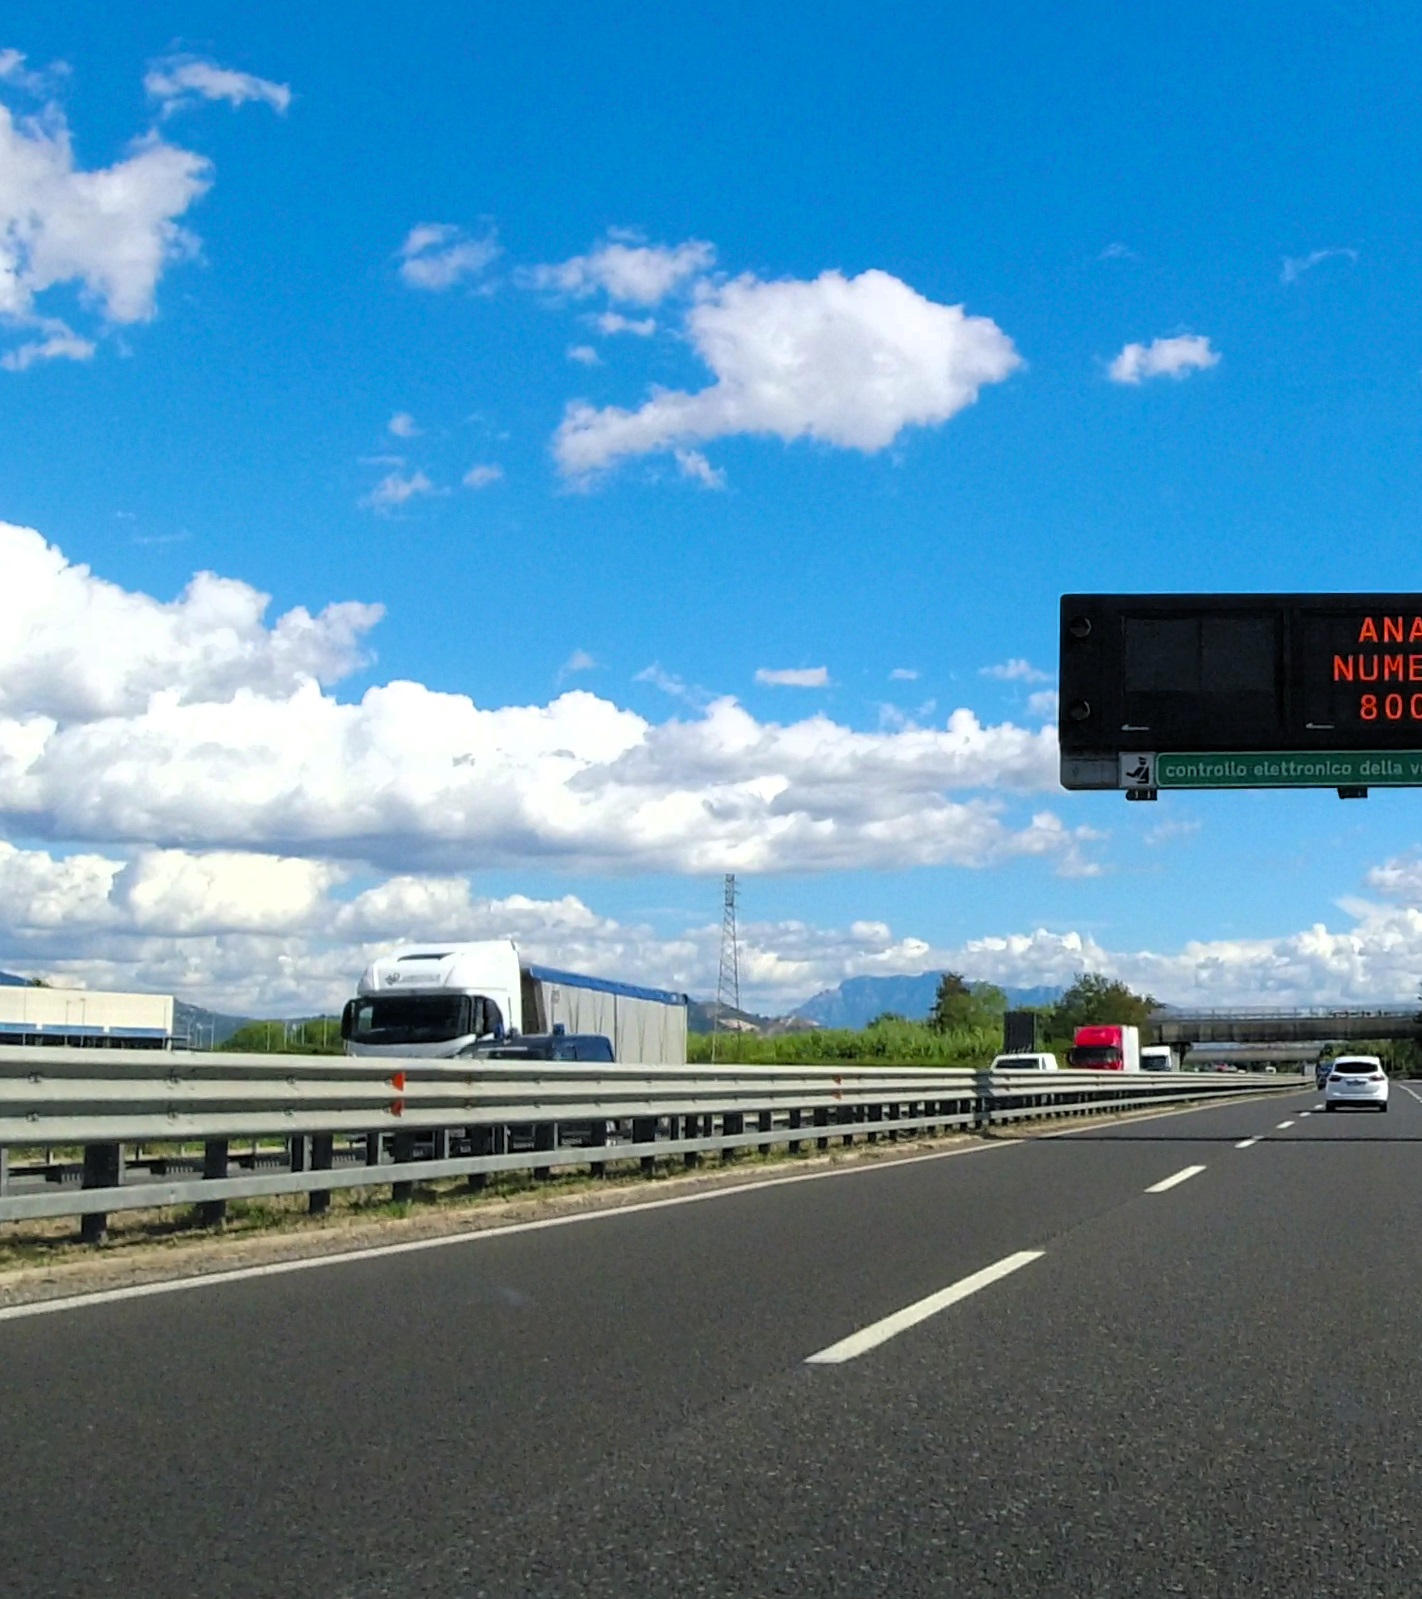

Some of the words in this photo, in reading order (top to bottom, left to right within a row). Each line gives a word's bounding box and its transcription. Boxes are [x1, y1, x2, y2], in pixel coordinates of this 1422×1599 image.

[1165, 761, 1247, 778] controllo
[1253, 760, 1352, 777] elettronico
[1359, 760, 1403, 776] della
